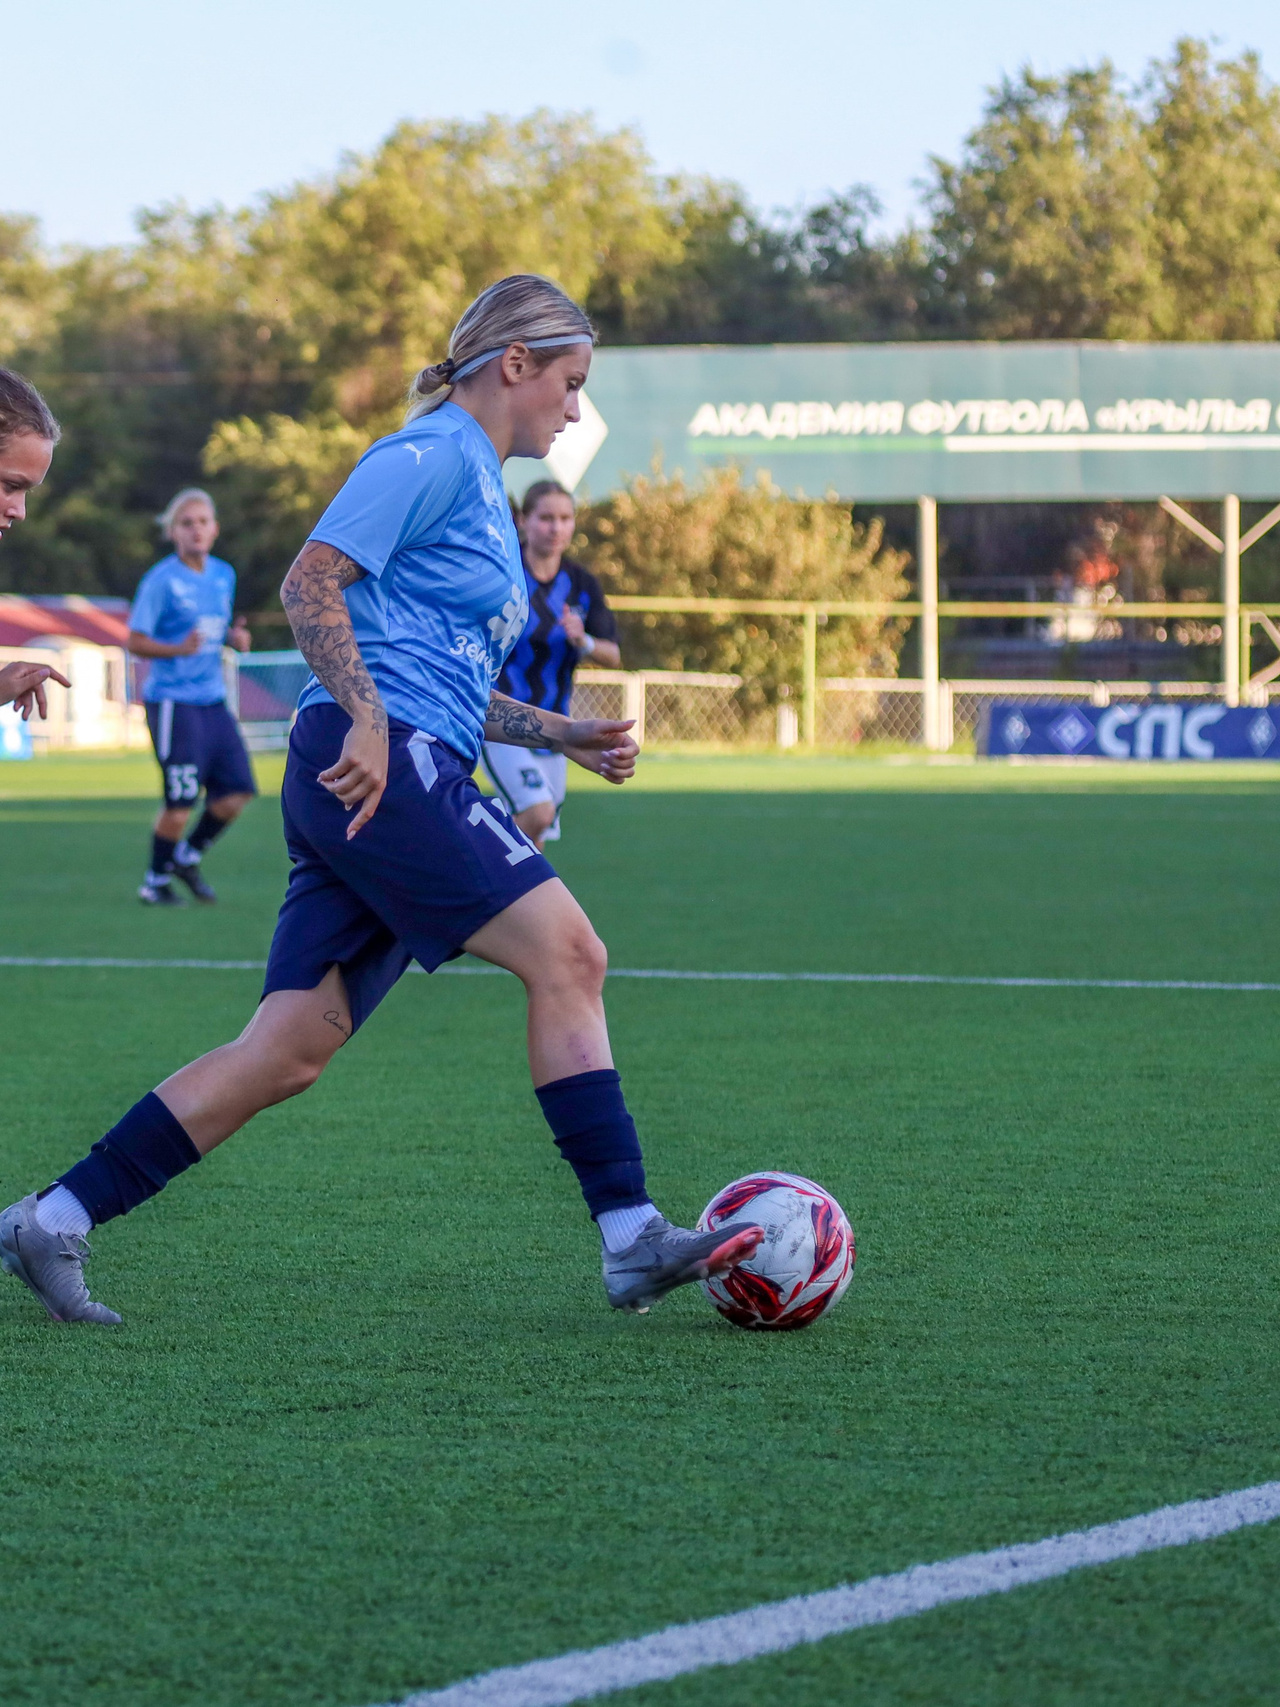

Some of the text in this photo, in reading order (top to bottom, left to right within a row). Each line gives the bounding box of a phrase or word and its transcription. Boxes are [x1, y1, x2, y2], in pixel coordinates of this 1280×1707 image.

[688, 402, 904, 439] АКАДЕМИЯ
[908, 399, 1089, 434] ФУТБОЛА
[1097, 702, 1226, 760] СПС
